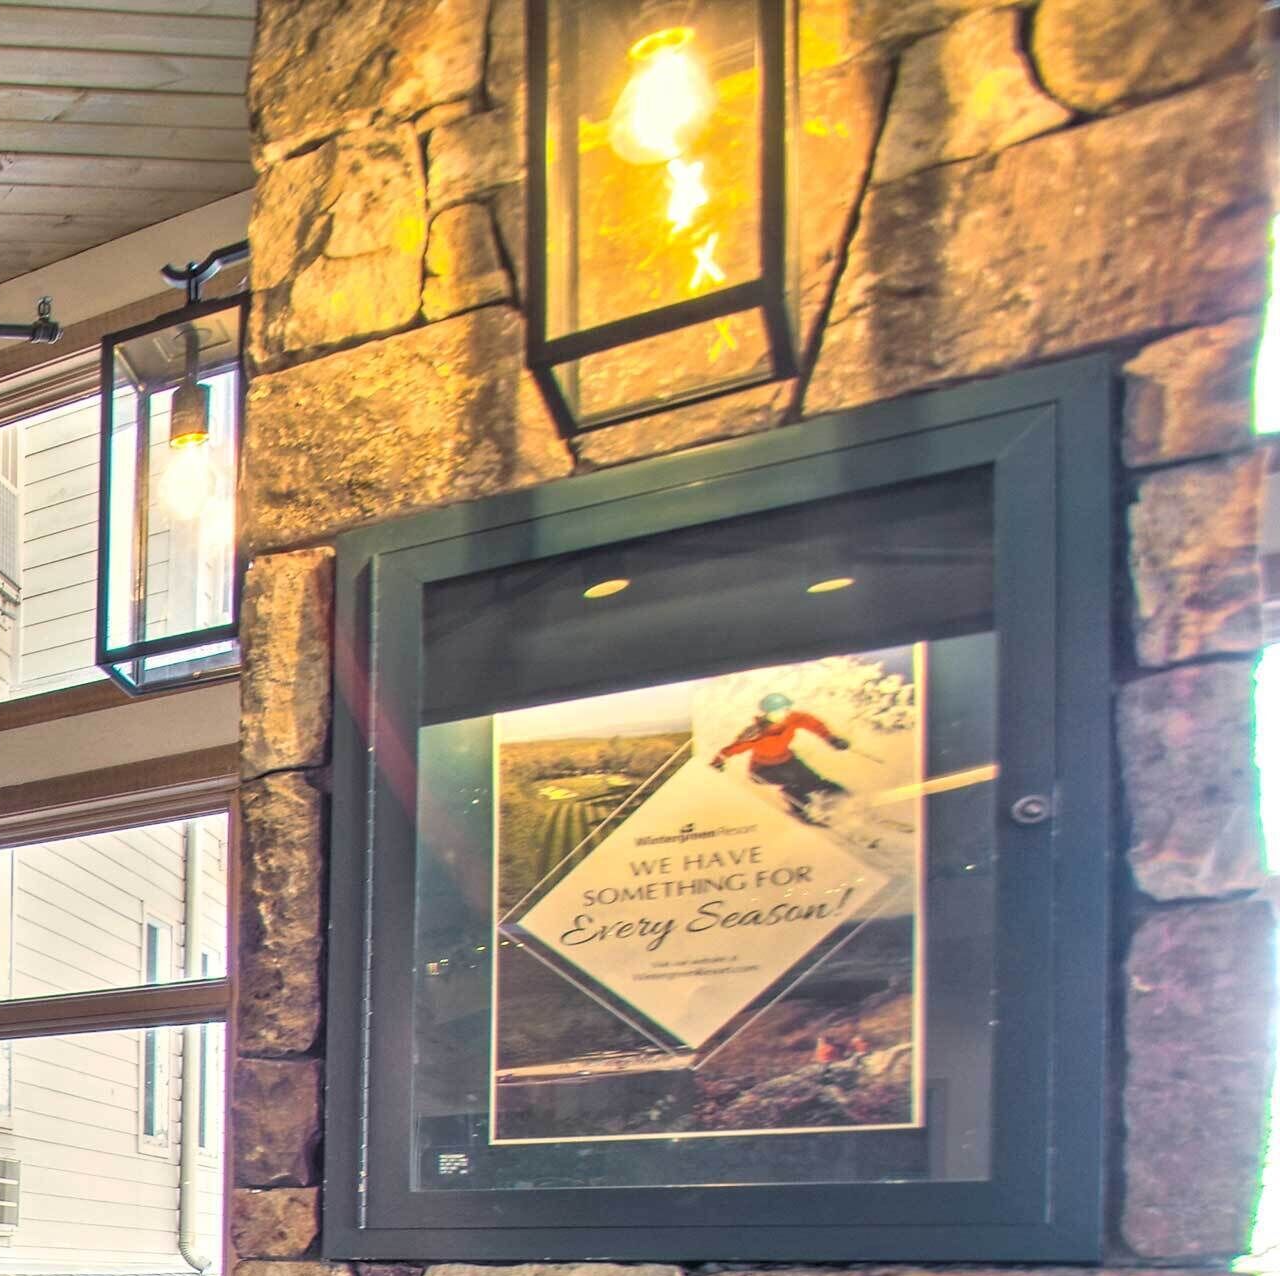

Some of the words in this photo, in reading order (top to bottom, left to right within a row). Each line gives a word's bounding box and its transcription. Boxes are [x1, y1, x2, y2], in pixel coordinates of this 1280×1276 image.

[629, 856, 672, 877] WE
[683, 845, 763, 871] HAVE
[581, 873, 745, 907] SOMETHING
[755, 864, 814, 888] FOR
[560, 914, 678, 951] Every
[685, 886, 856, 933] Season!
